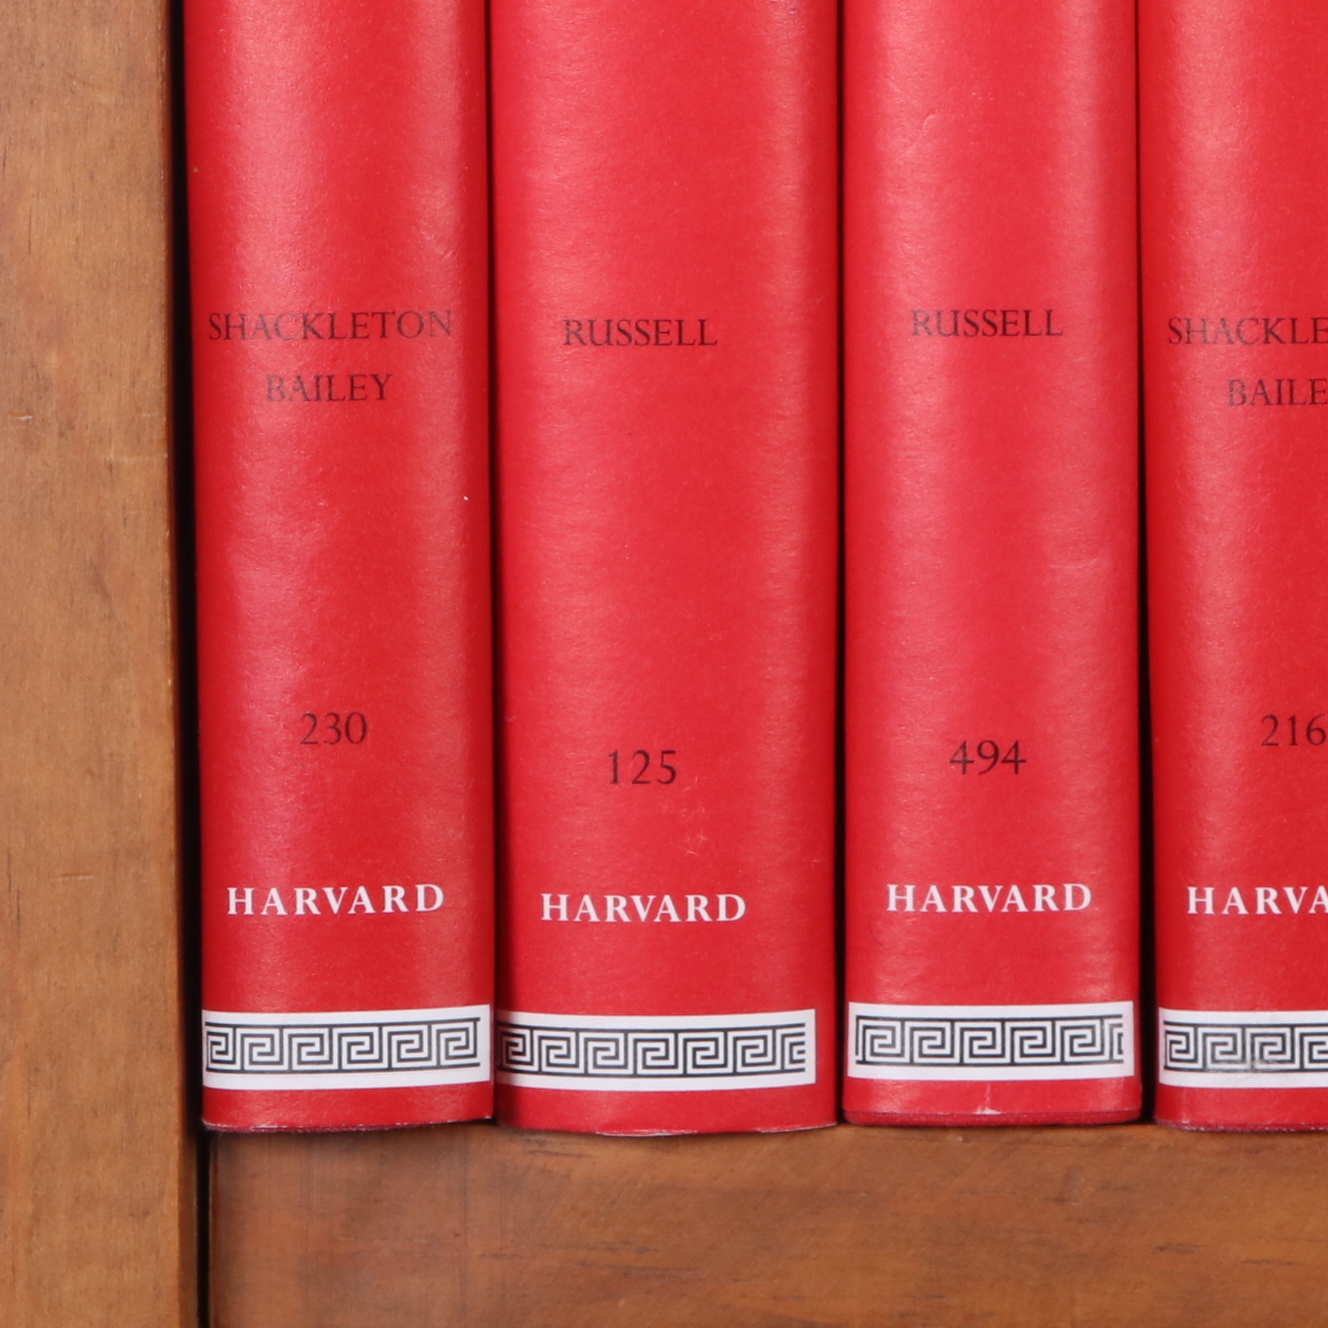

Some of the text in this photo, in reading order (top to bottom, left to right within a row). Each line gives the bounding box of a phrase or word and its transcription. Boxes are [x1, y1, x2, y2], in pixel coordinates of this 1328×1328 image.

[207, 308, 454, 342] SHACKLETON
[562, 317, 719, 348] RUSSELL
[909, 308, 1064, 338] RUSSELL
[264, 372, 393, 403] BAILEY
[299, 710, 369, 747] 230
[1260, 712, 1328, 748] 216
[606, 749, 678, 786] 125
[948, 739, 1028, 776] 494
[226, 882, 445, 917] HARVARD
[540, 891, 747, 923] HARVARD
[885, 882, 1092, 914] HARVARD
